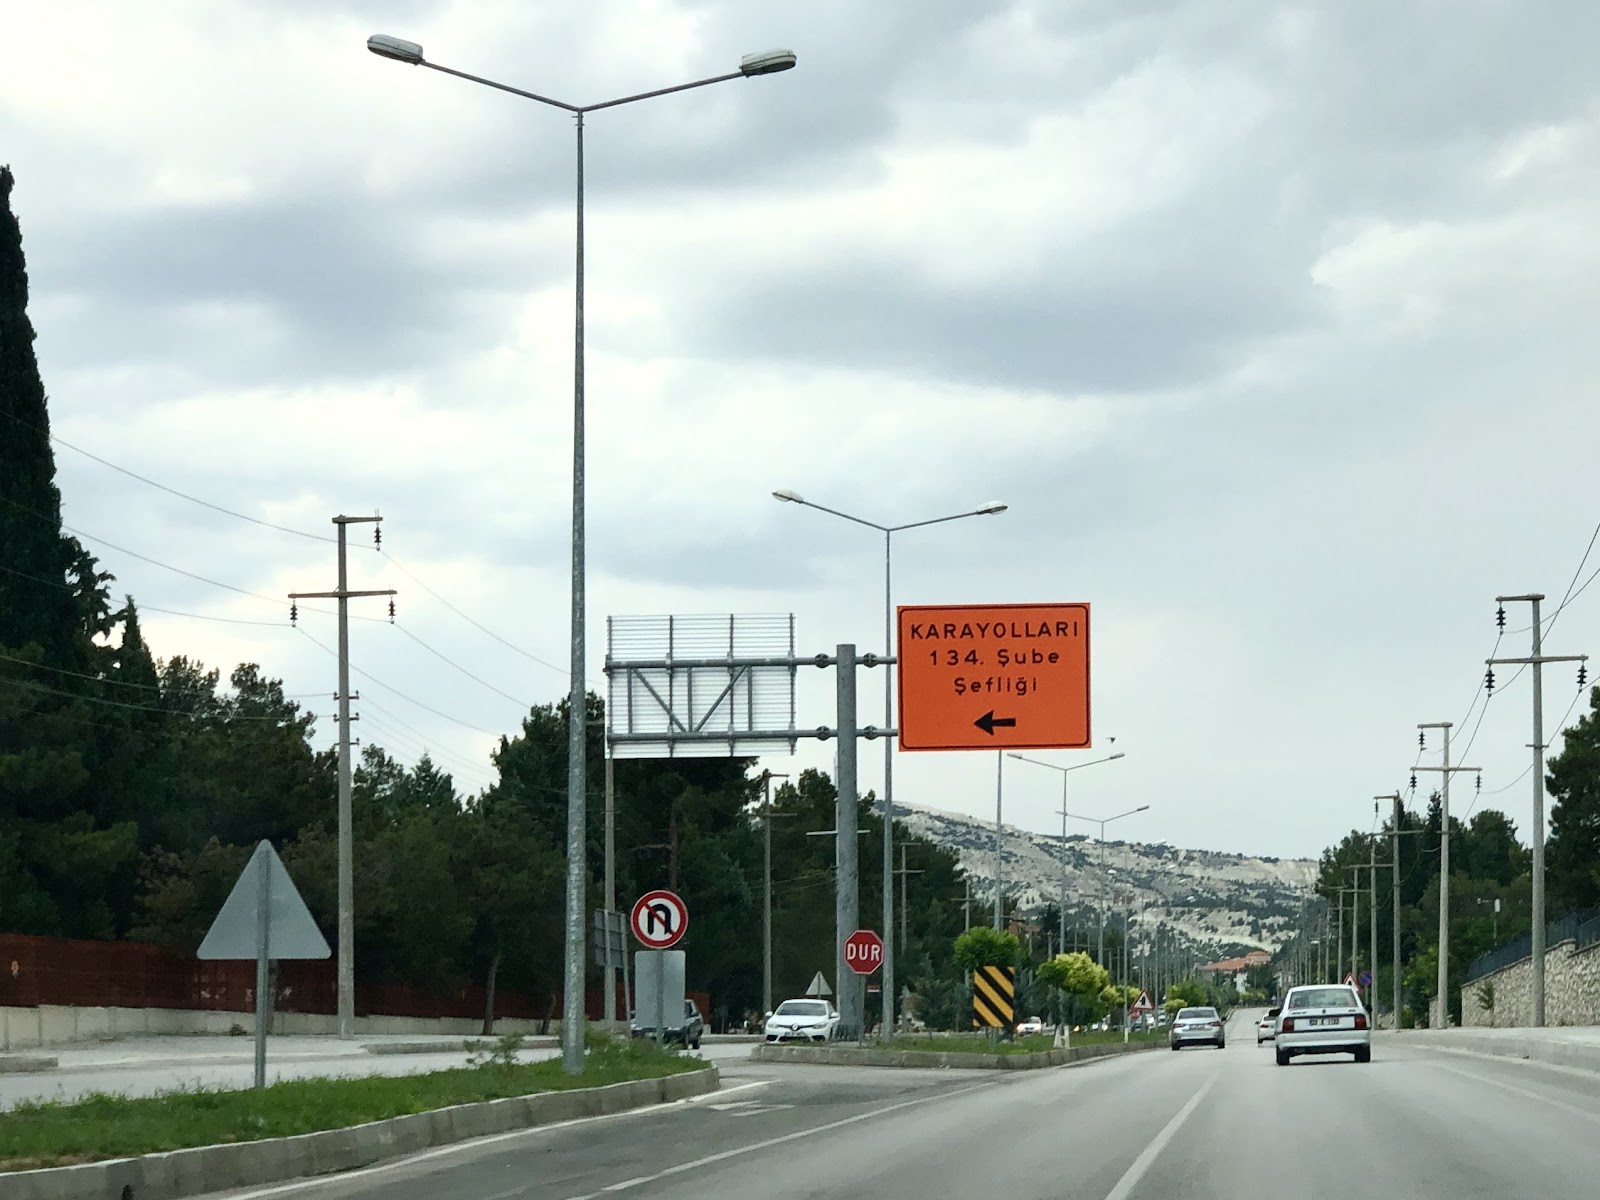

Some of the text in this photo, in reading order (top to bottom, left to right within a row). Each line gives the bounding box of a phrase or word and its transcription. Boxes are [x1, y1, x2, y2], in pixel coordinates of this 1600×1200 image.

[910, 621, 1078, 639] KARAYOLLARI
[929, 649, 1060, 667] 134. Şube
[954, 677, 1037, 695] Şefliği
[847, 943, 880, 961] DUR
